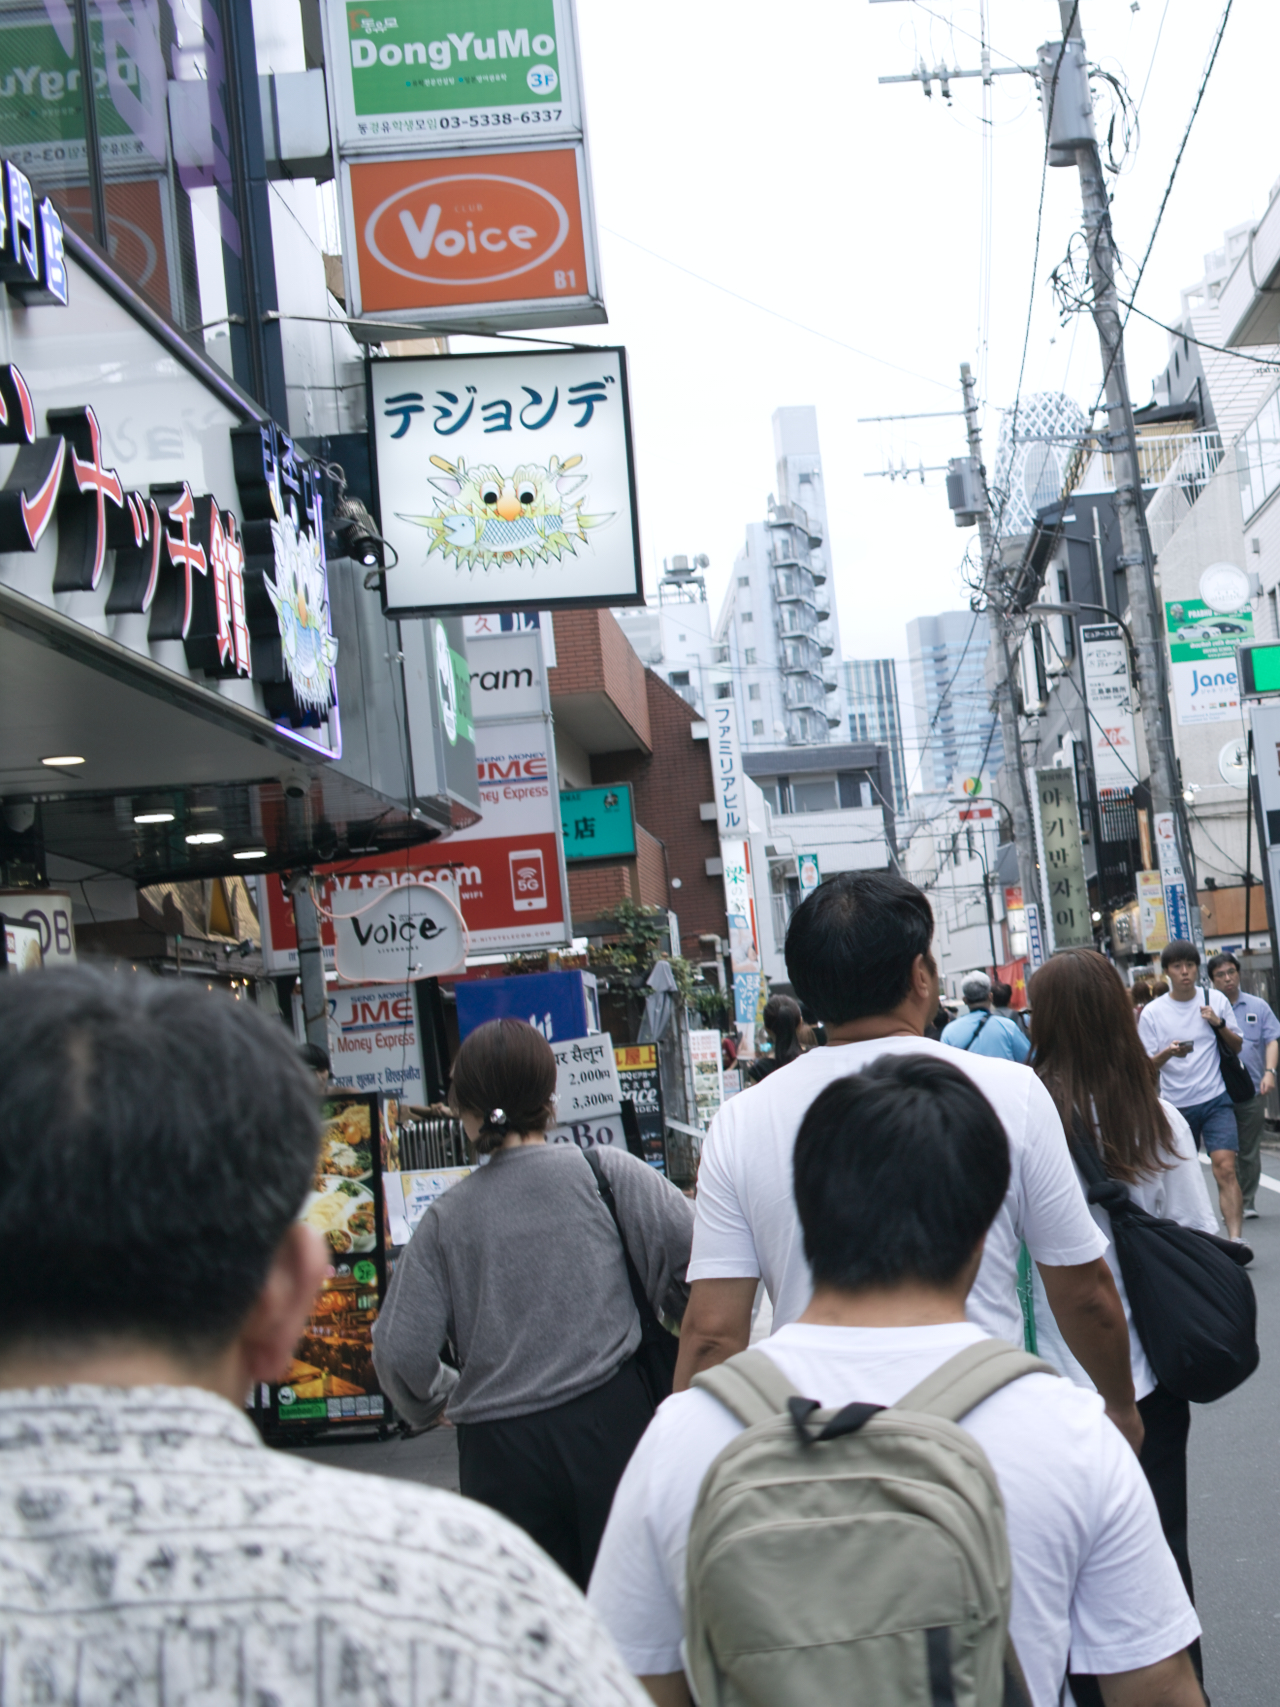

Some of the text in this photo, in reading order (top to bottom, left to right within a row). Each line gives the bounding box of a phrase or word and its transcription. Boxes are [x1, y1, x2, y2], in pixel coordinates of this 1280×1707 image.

[351, 28, 556, 70] DongYuMo
[530, 72, 556, 88] 3F
[439, 109, 563, 130] 03-5338-6337
[398, 203, 538, 260] Voice
[553, 268, 577, 290] B1
[384, 375, 616, 439] テジョンデ
[715, 708, 740, 828] ファミリアビル
[503, 785, 549, 802] Express
[1042, 787, 1075, 930] 야키반자이
[517, 879, 539, 892] 5G
[350, 913, 447, 946] Voice
[340, 998, 414, 1026] JME
[337, 1032, 416, 1054] Money Express
